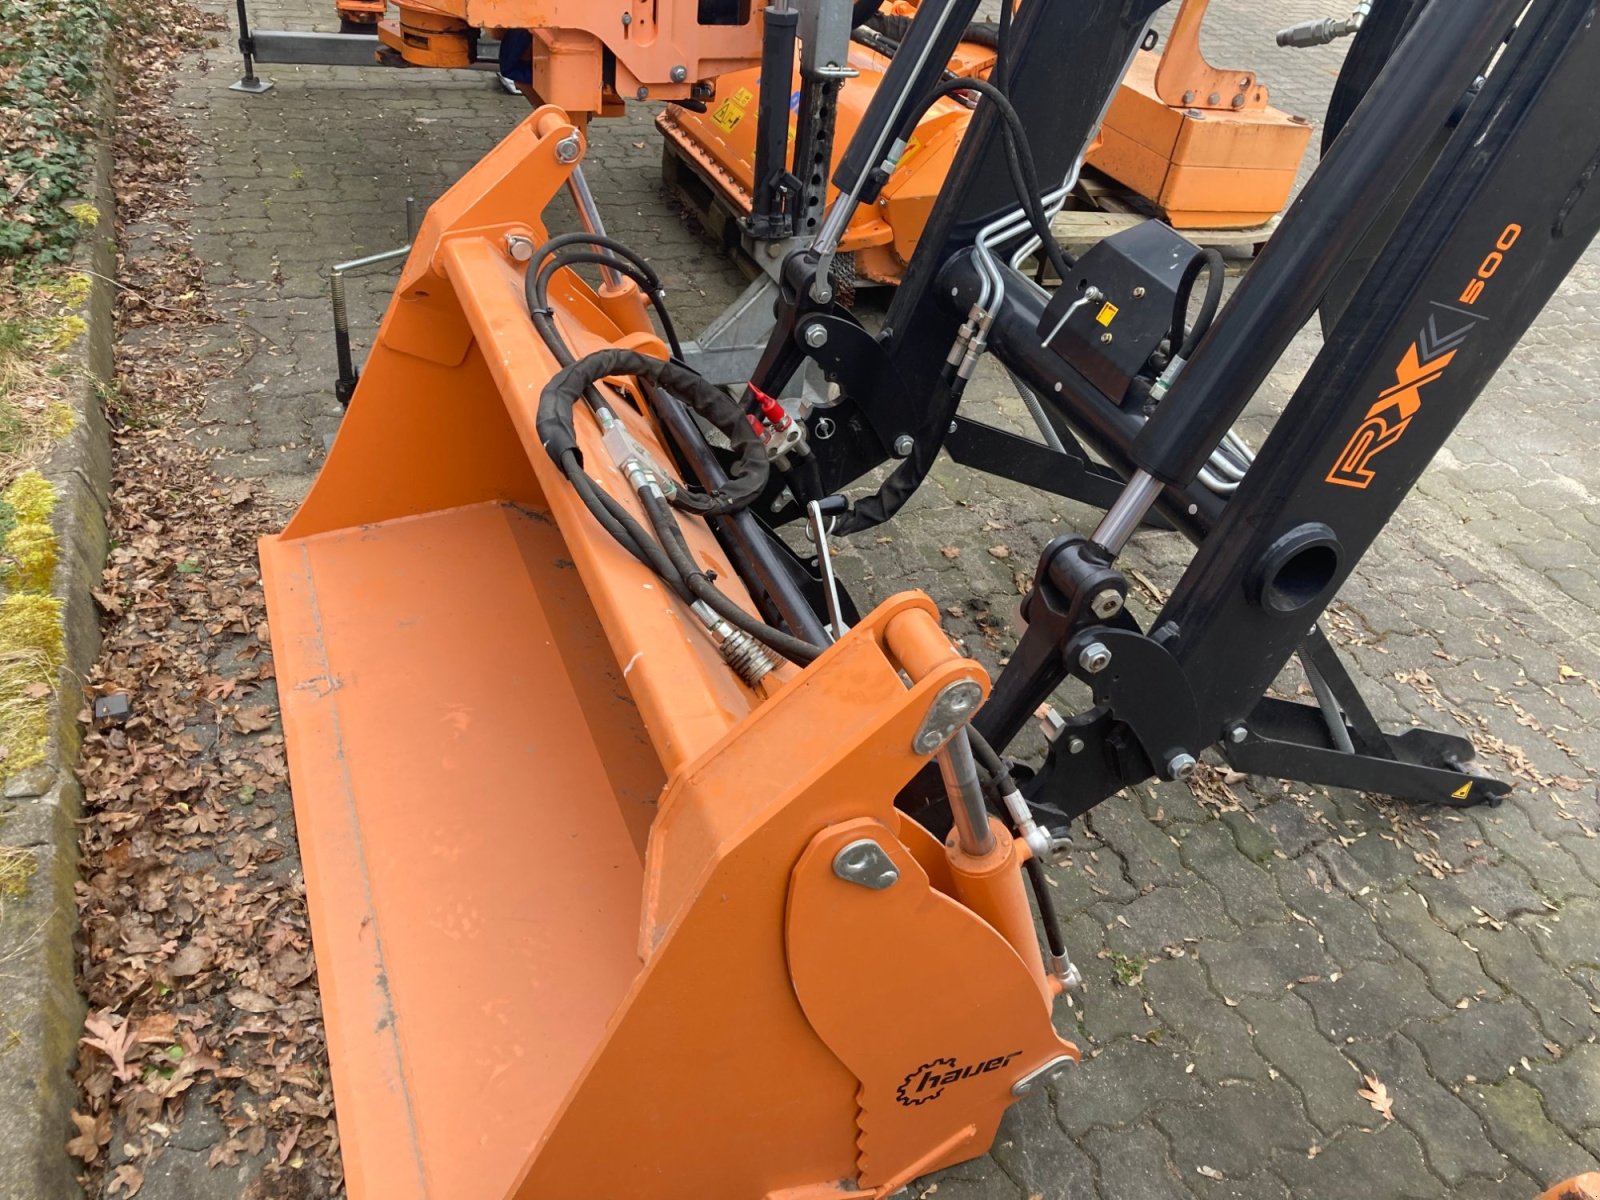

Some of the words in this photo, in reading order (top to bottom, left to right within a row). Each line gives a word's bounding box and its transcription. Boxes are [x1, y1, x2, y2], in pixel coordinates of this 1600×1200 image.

[1324, 341, 1458, 489] RX
[1458, 223, 1522, 305] 500
[915, 1050, 1023, 1093] hauer
